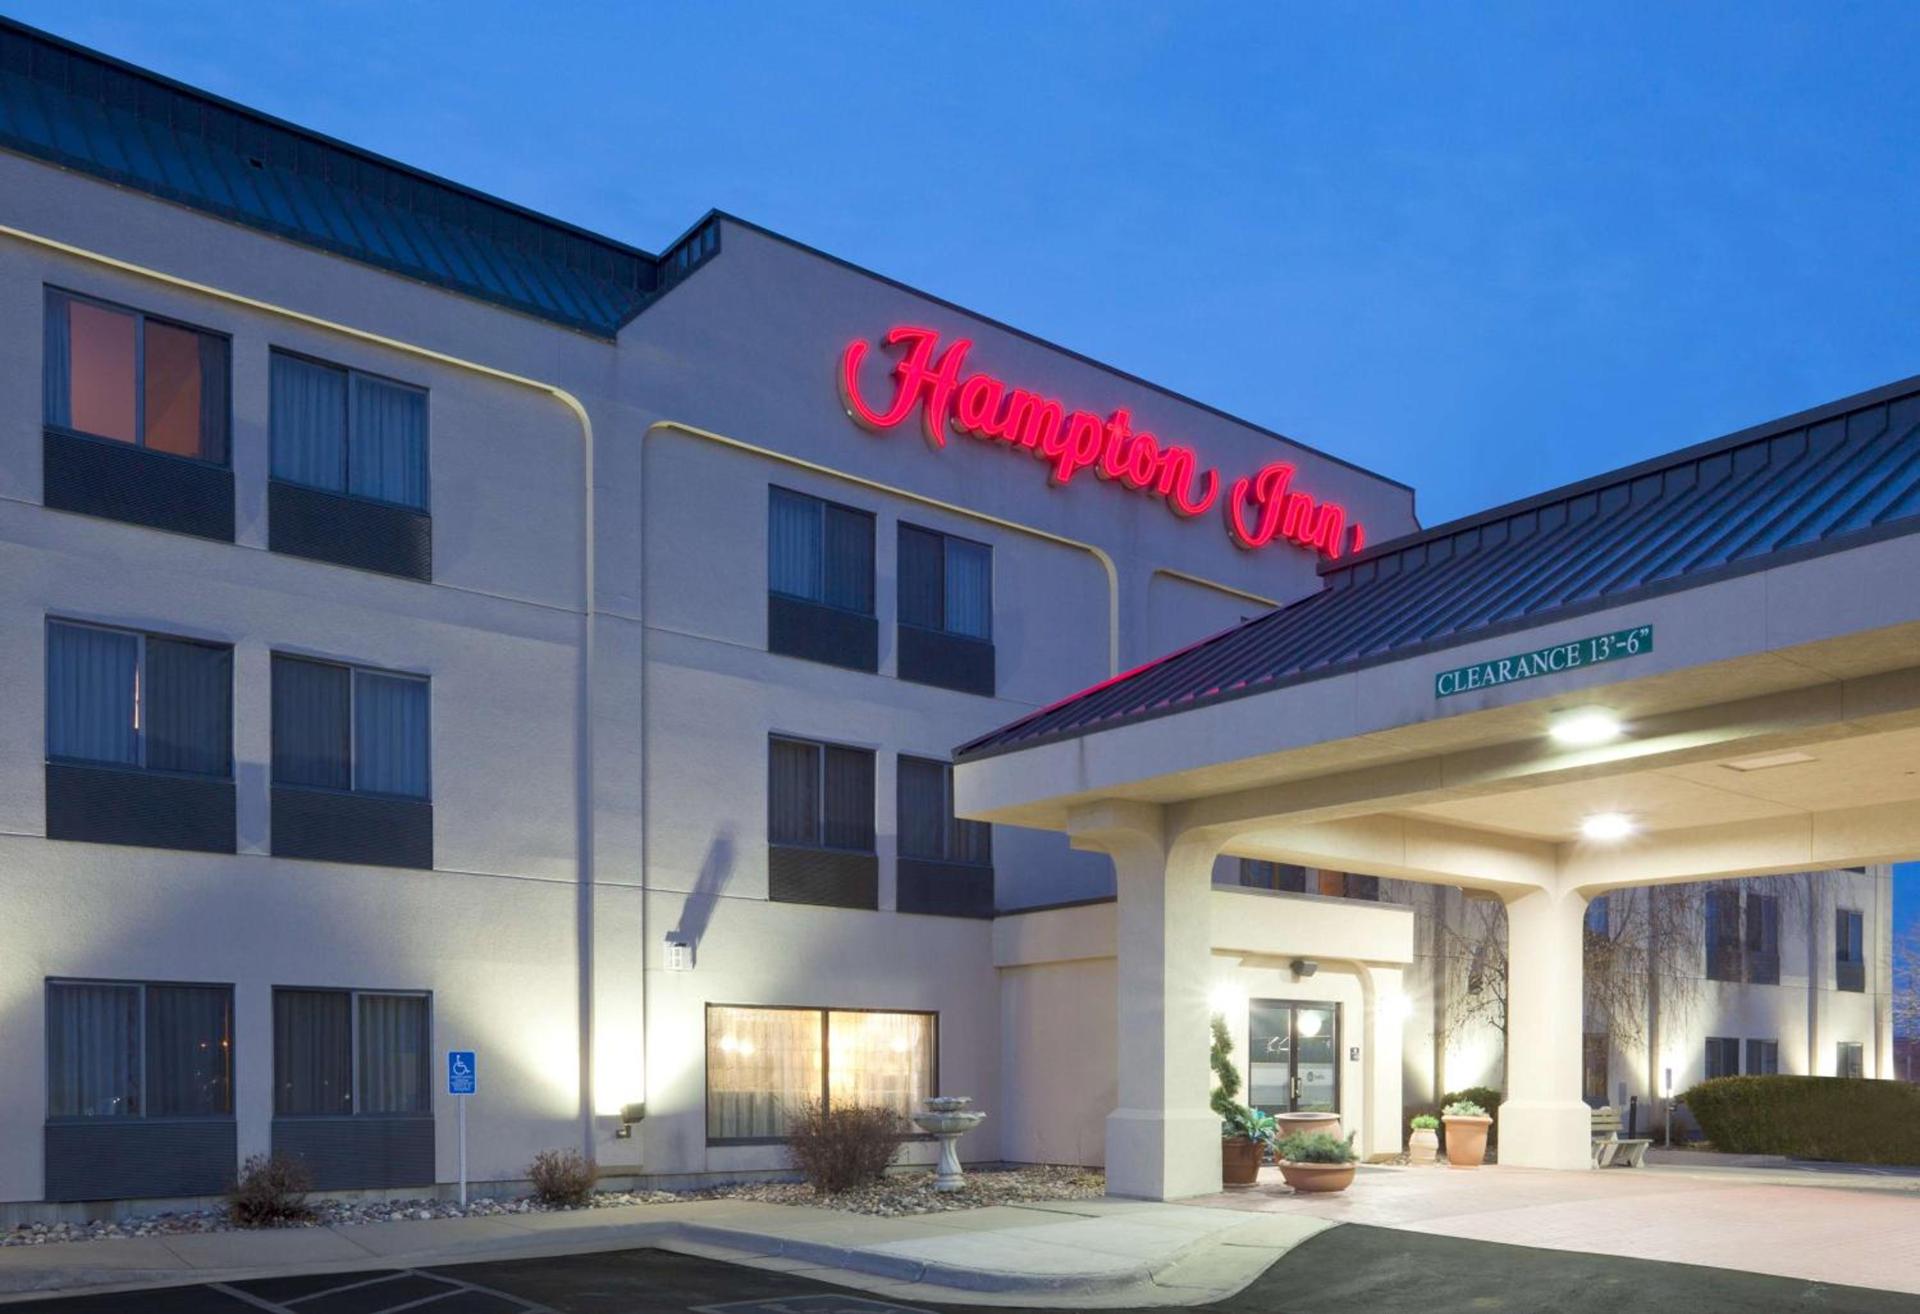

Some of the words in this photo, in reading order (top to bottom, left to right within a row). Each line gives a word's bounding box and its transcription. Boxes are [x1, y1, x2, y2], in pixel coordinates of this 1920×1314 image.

[841, 326, 1219, 517] Hampton
[1227, 461, 1365, 559] Inn
[1437, 643, 1581, 696] CLEARANCE
